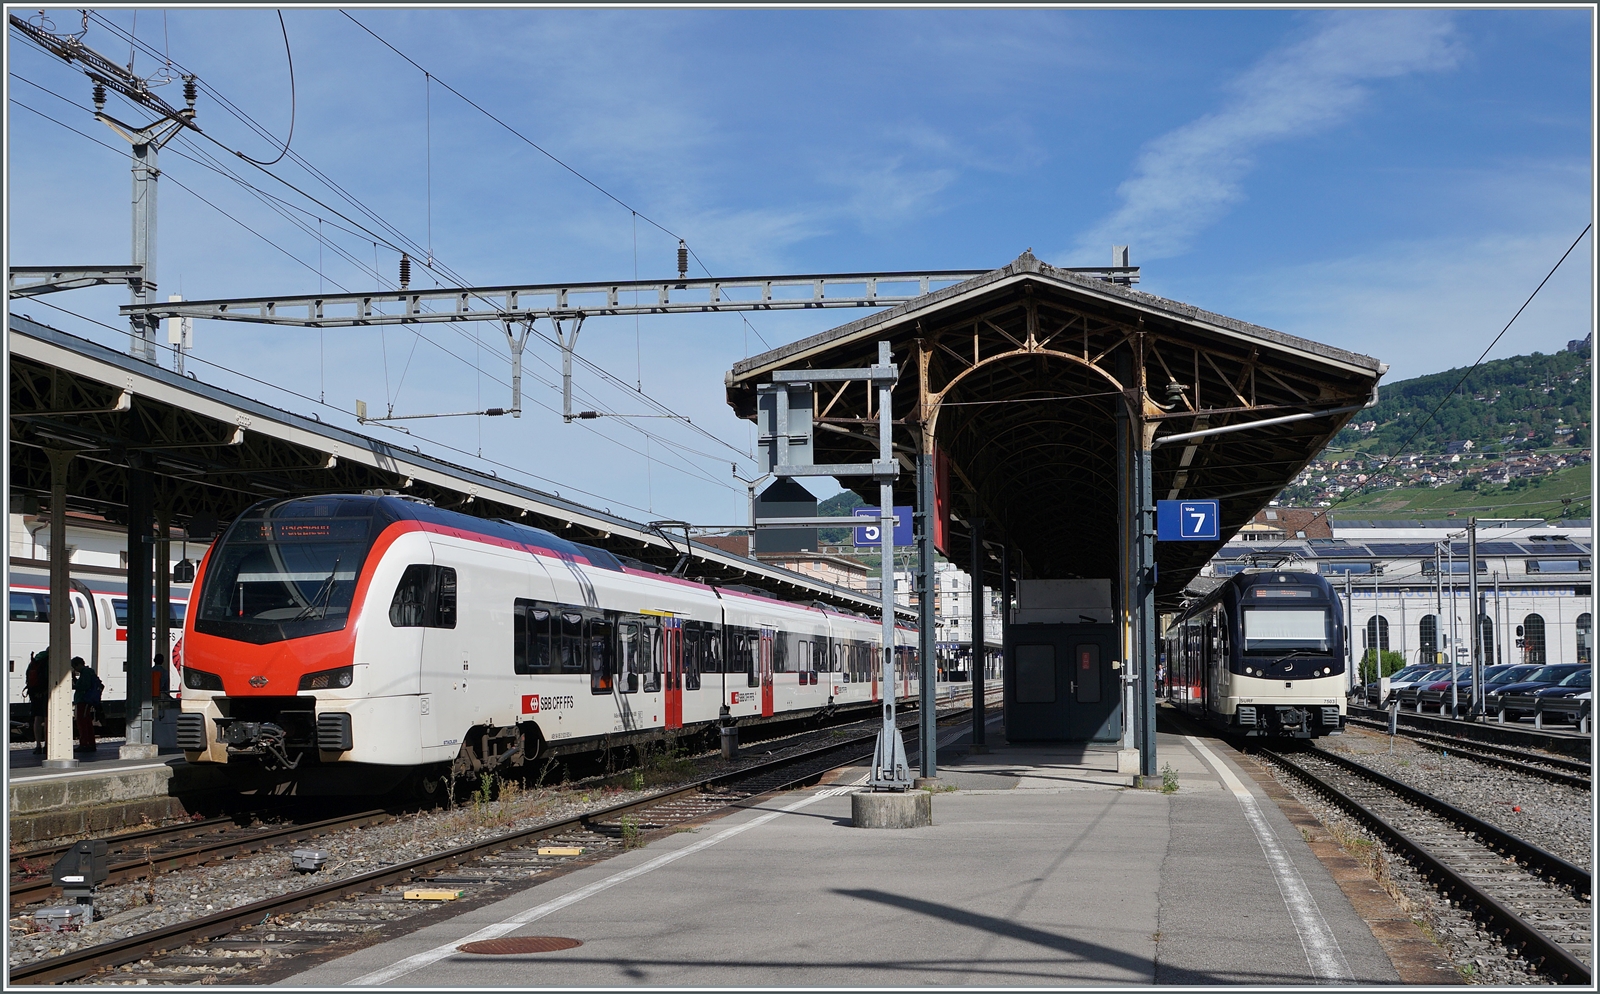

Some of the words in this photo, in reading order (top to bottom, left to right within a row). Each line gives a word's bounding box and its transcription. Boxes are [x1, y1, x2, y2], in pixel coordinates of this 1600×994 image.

[1190, 513, 1206, 533] 7
[865, 526, 880, 540] 5
[540, 696, 552, 711] SBB
[553, 695, 563, 710] CFF
[564, 695, 574, 709] FFS
